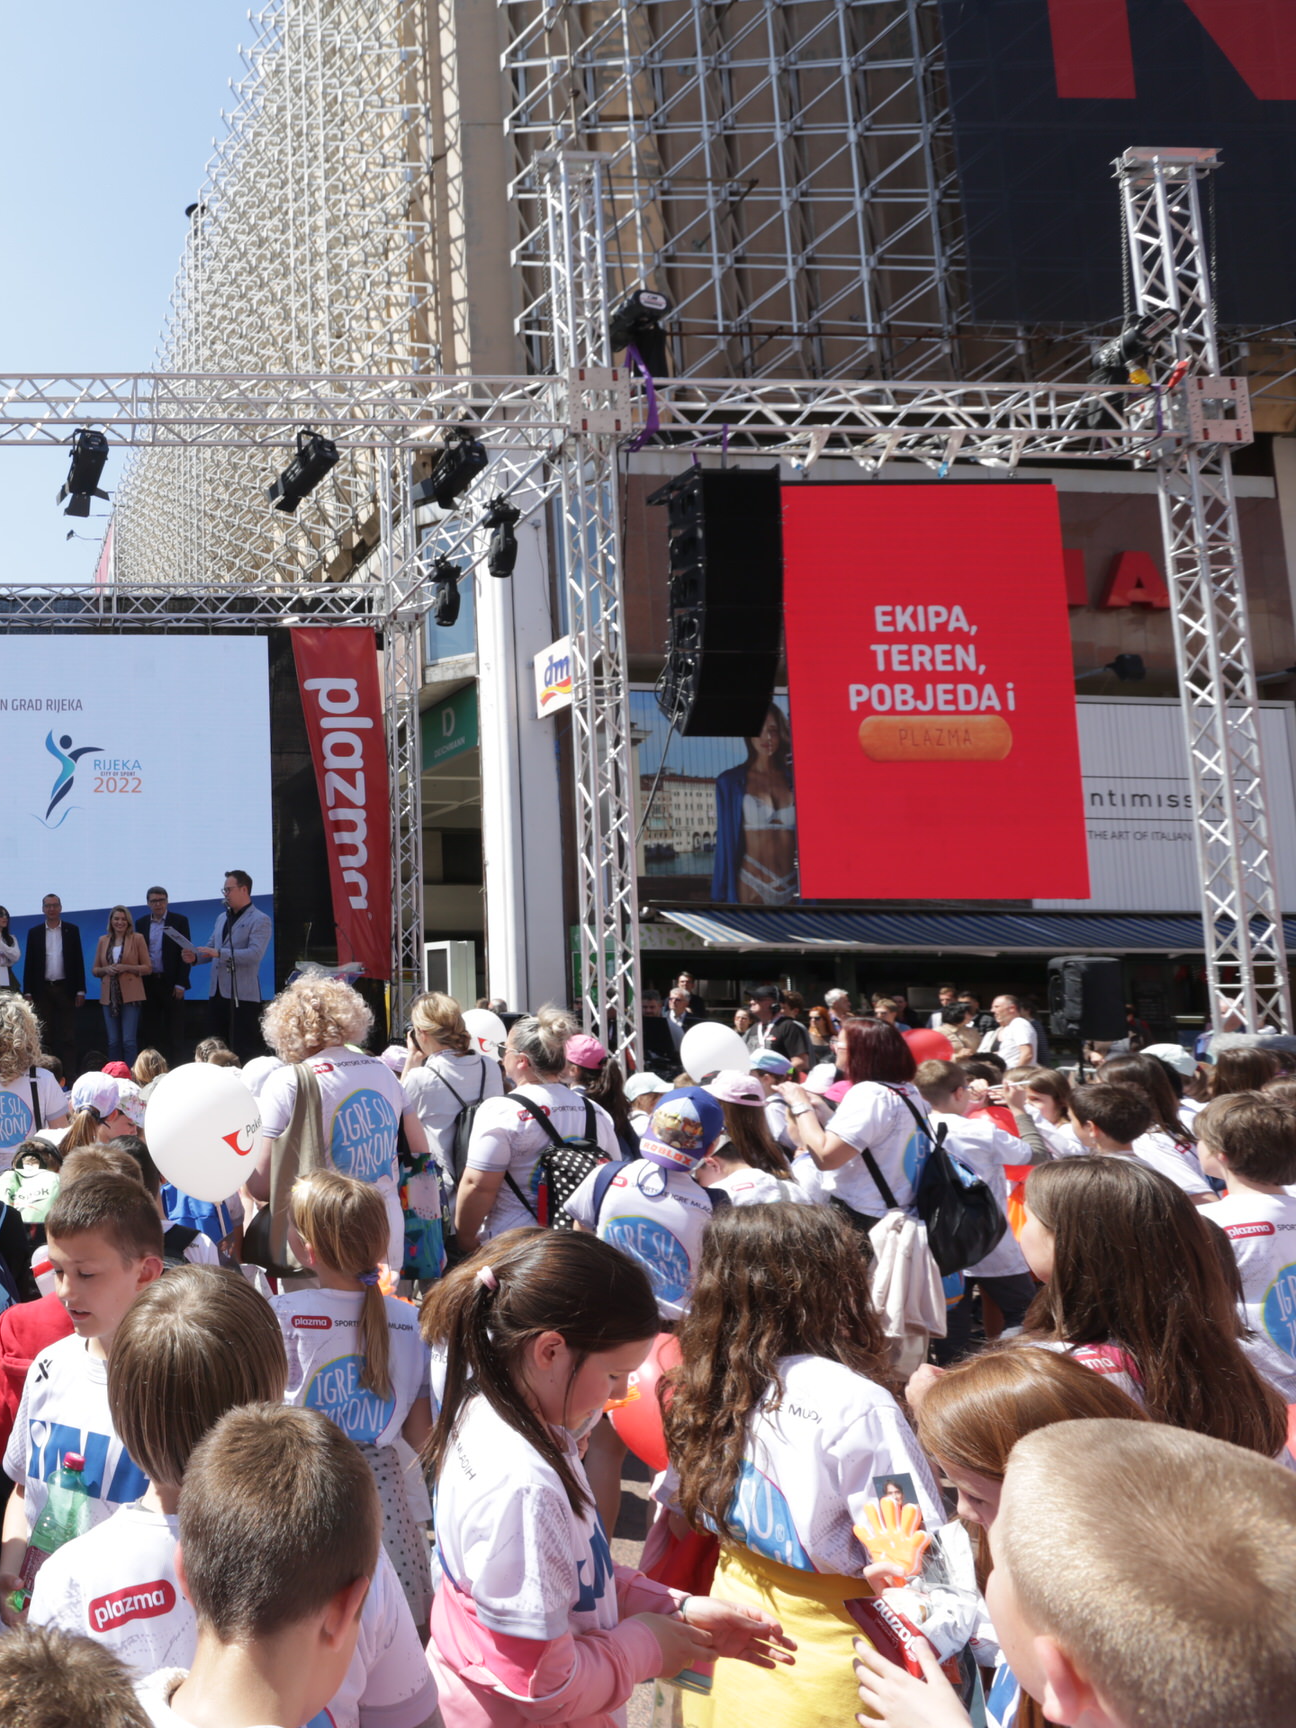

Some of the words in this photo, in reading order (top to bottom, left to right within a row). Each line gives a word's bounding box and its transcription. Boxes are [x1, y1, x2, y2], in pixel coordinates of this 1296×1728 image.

[874, 605, 978, 636] EKIPA,
[544, 655, 570, 688] dm
[869, 644, 986, 675] TEREN,
[11, 698, 42, 711] GRAD
[45, 698, 83, 713] RIJEKA
[848, 683, 1002, 712] POBJEDA
[1006, 682, 1015, 711] i
[898, 728, 973, 747] PLAZMA
[93, 759, 142, 771] RIJEKA
[93, 776, 142, 793] 2022
[1111, 831, 1128, 841] ART
[336, 1097, 375, 1146] IGRE
[643, 1142, 693, 1167] ROBLOX
[1226, 1225, 1270, 1238] plazma
[294, 1317, 327, 1327] plazma
[315, 1362, 356, 1406] IGRE
[94, 1589, 165, 1629] plazma
